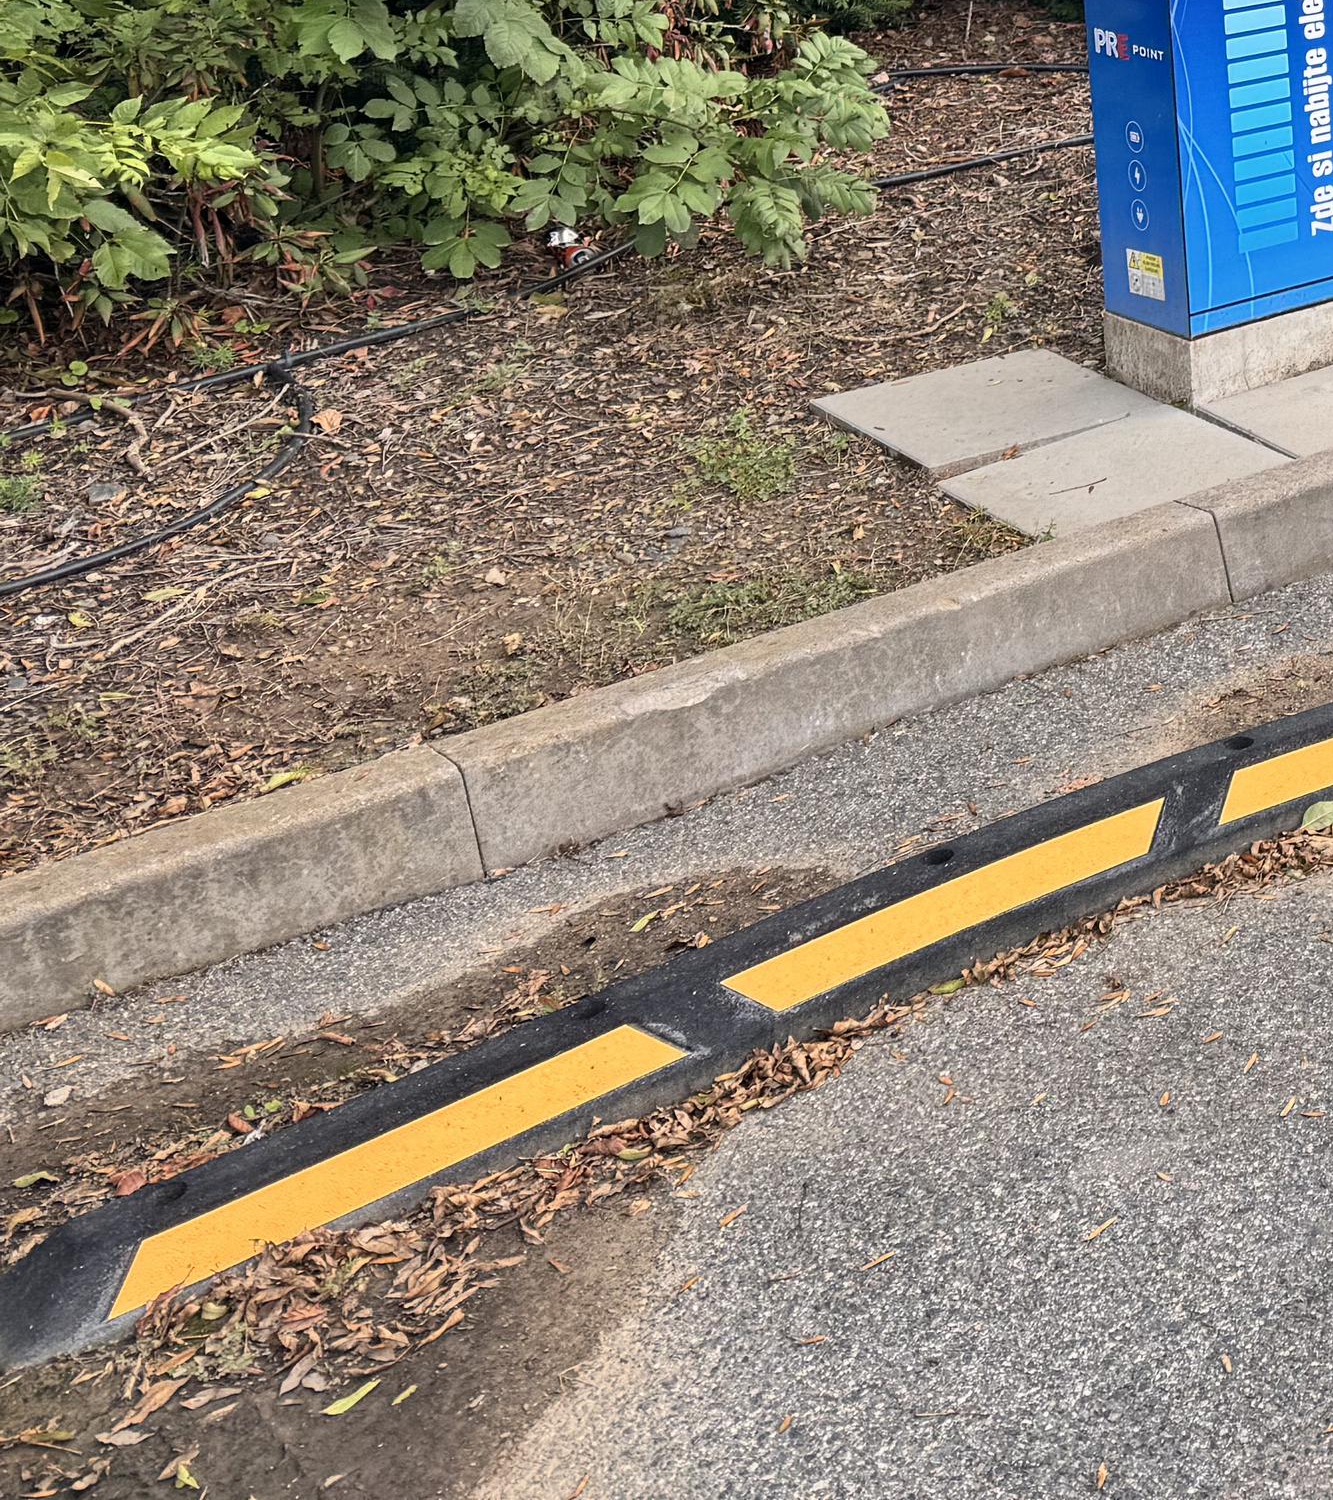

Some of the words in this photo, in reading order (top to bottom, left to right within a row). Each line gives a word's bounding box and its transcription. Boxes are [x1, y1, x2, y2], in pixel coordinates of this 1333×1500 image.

[1094, 27, 1130, 62] PRE
[1132, 44, 1165, 61] POINT
[1303, 47, 1333, 144] nabijte
[1307, 154, 1333, 177] si
